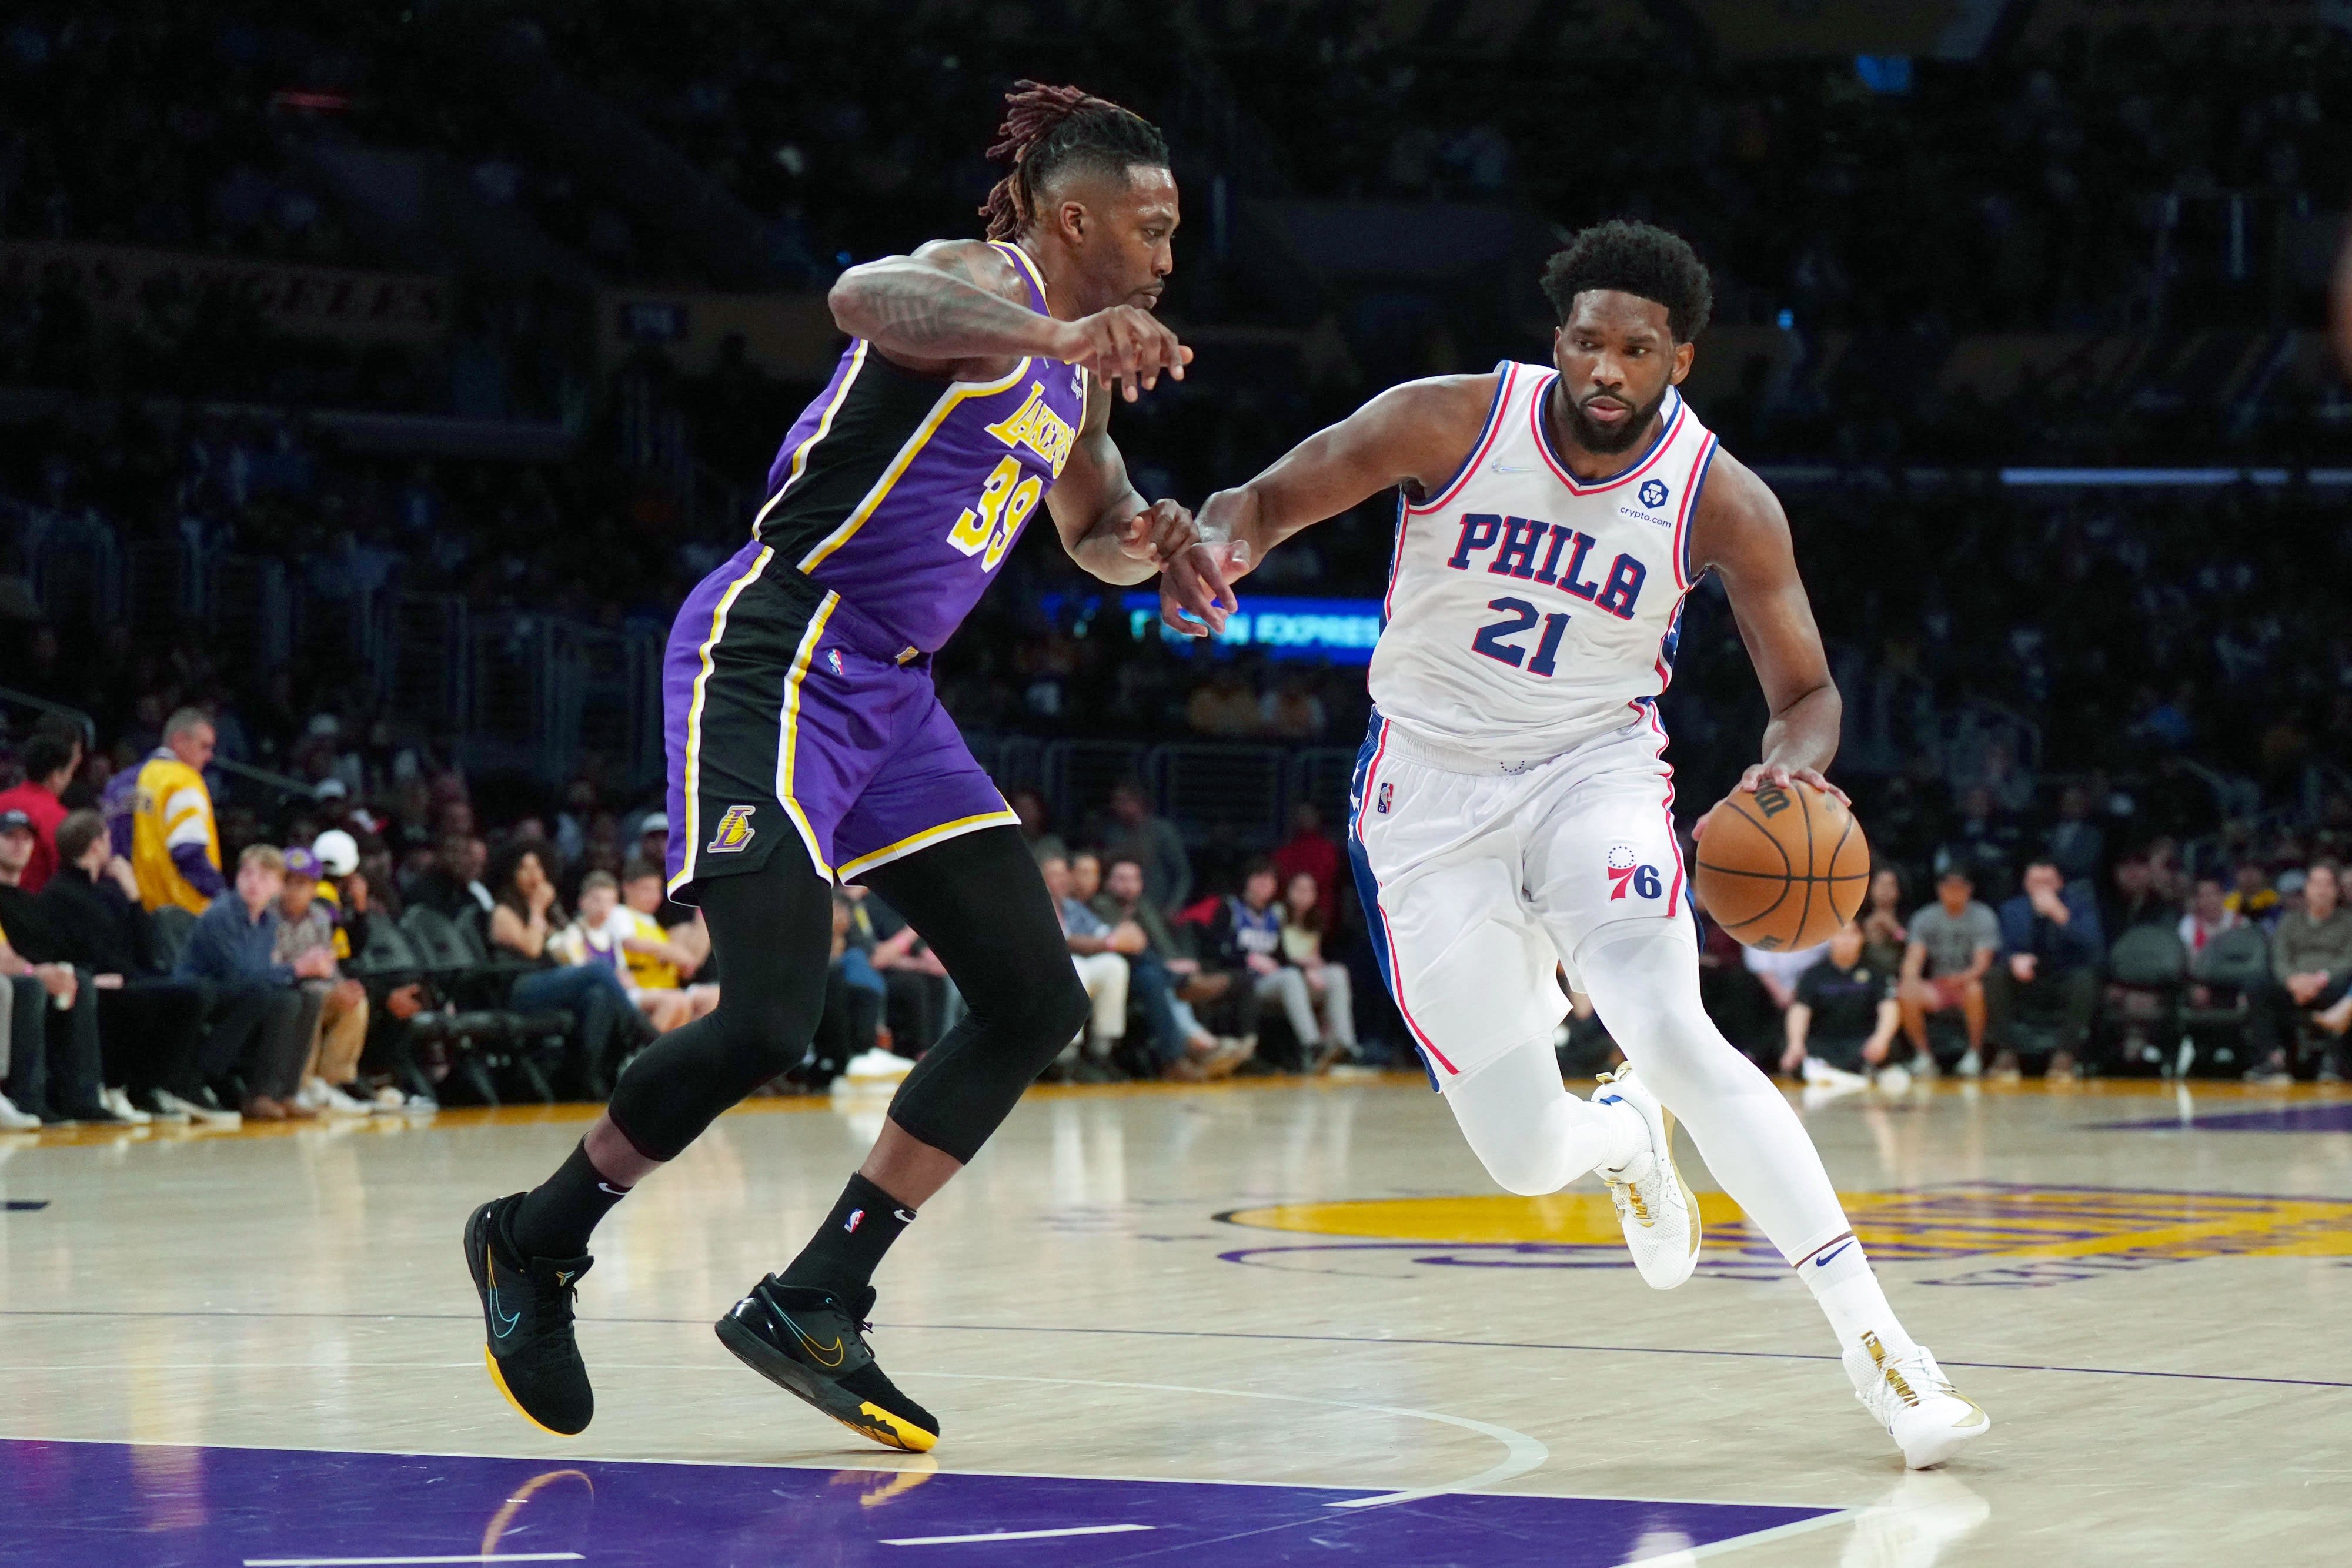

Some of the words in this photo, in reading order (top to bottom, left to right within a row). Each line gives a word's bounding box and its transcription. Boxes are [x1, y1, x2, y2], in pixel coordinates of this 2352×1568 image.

[984, 380, 1076, 479] LAKERS
[946, 454, 1043, 573] 39
[1620, 507, 1671, 529] crypto.com
[1447, 513, 1647, 620] PHILA
[1471, 596, 1571, 677] 21
[1607, 863, 1662, 902] 76
